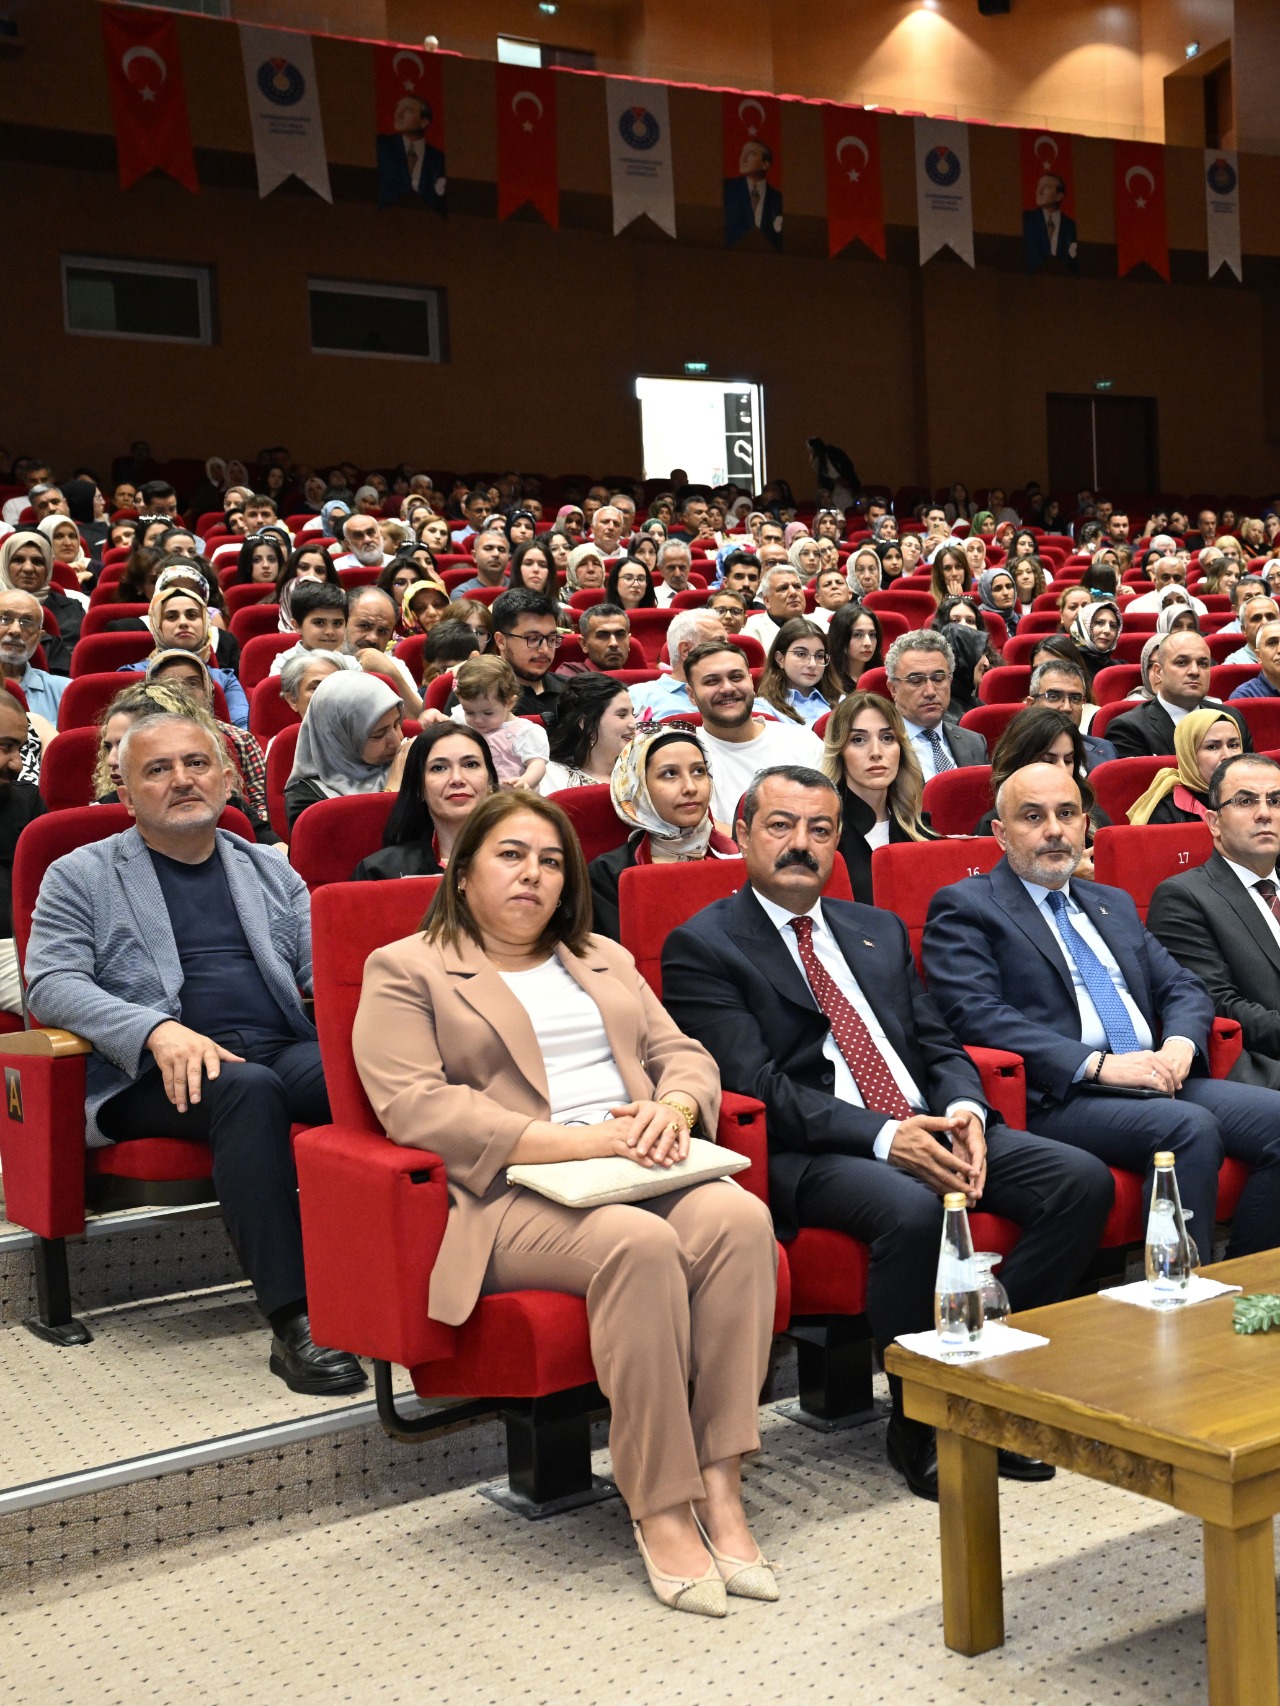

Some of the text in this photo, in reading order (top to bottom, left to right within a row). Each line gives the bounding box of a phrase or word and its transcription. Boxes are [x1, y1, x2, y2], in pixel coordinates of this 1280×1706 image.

[1177, 851, 1190, 864] 17
[966, 866, 980, 877] 16
[9, 1075, 22, 1117] A
